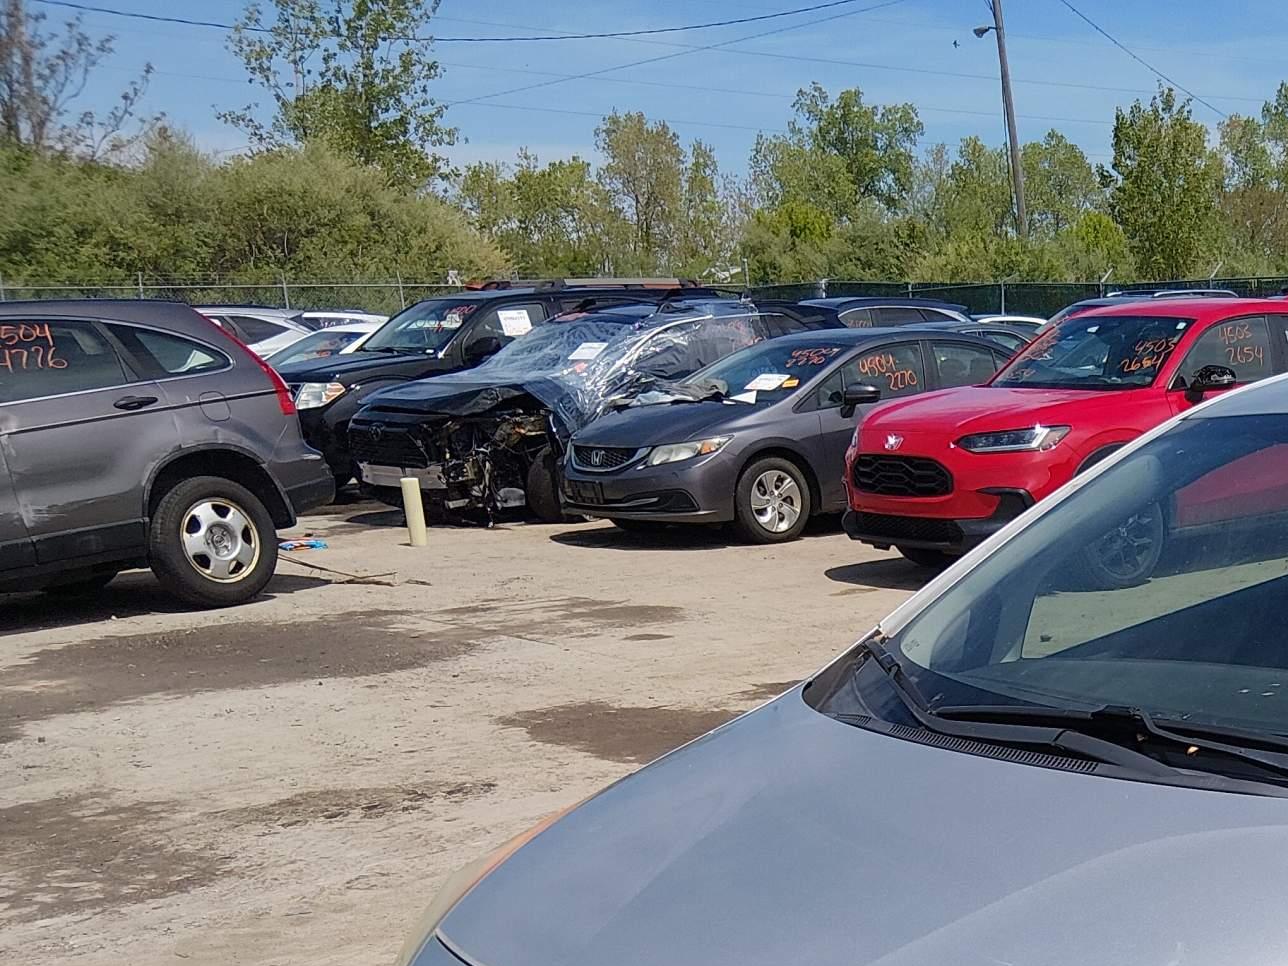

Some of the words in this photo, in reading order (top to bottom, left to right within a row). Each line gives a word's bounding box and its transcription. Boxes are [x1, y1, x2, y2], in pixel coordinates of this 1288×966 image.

[1219, 323, 1252, 345] 4503
[1134, 337, 1175, 355] 4503
[1225, 346, 1264, 366] 2654
[859, 354, 896, 377] 4504
[885, 370, 918, 391] 2270
